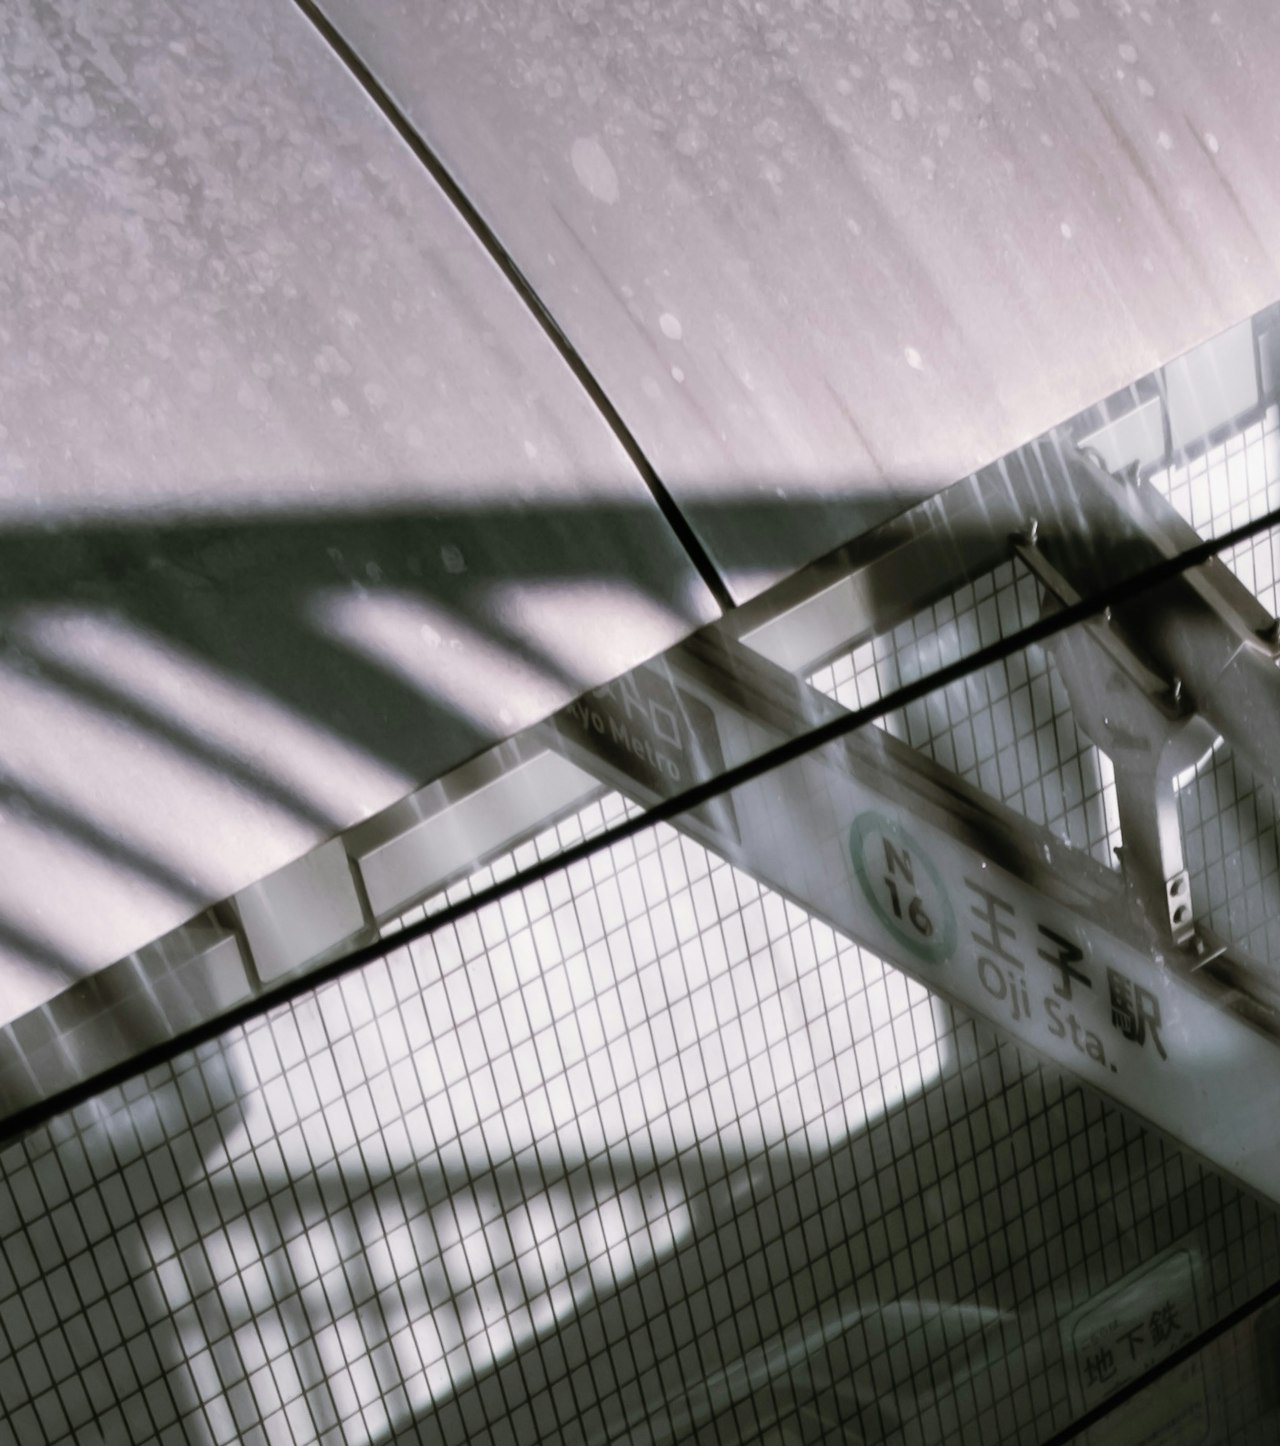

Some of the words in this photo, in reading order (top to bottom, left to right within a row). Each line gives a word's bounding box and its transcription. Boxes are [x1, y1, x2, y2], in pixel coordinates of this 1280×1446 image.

[609, 715, 680, 780] Metro
[884, 839, 912, 885] N
[883, 879, 932, 938] 16
[964, 877, 1167, 1062] 王子駅
[978, 960, 1031, 1021] Oji
[1046, 998, 1119, 1075] Sta.
[1083, 1300, 1182, 1386] 地下鉄
